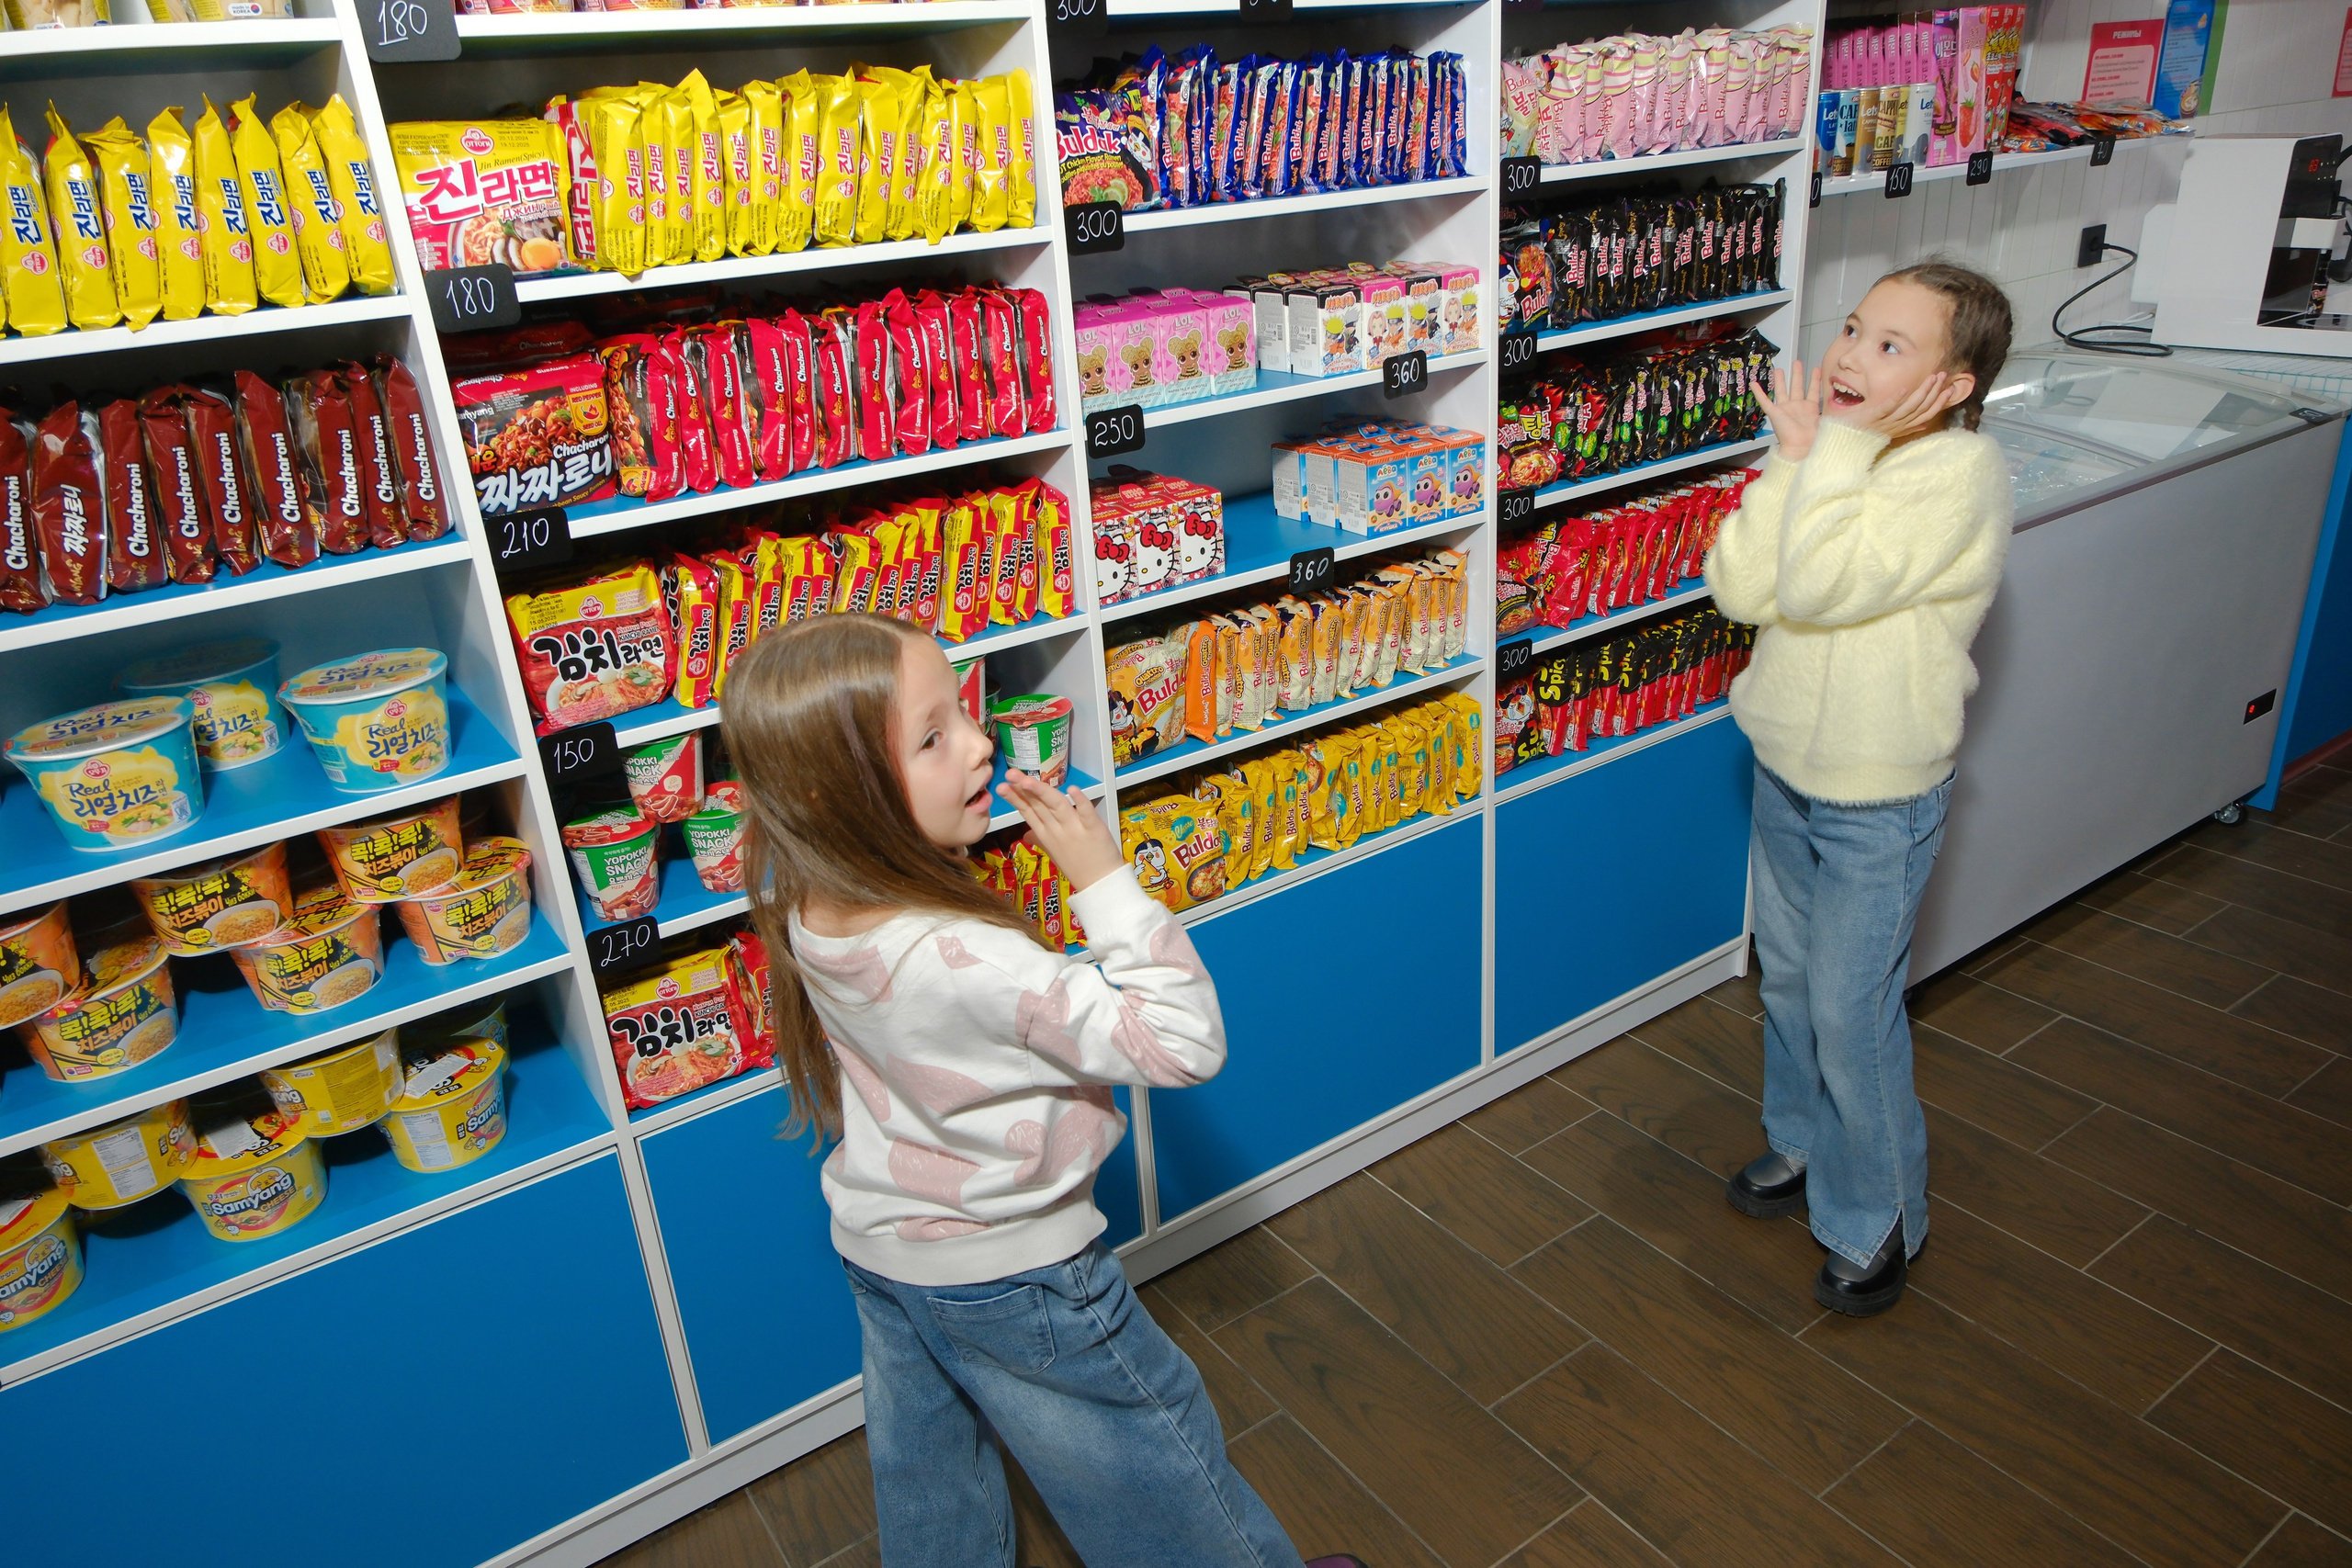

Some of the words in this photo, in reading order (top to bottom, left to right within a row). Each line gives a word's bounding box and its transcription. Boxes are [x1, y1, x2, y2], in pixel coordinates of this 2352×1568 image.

[379, 2, 427, 45] 180
[2113, 29, 2142, 39] РЕЖИМЫ
[1362, 109, 1373, 151] Buldak
[1387, 107, 1398, 148] Buldak
[1430, 107, 1442, 150] Buldak
[1455, 102, 1465, 140] Buldak
[1290, 118, 1302, 161] Buldak
[1318, 121, 1331, 162] Buldak
[1876, 136, 1894, 148] CAF
[480, 162, 492, 170] Jin
[494, 151, 545, 166] Ramen(Spicy)
[1508, 165, 1534, 191] 300
[416, 159, 555, 222] 진라면
[1890, 167, 1907, 190] 150
[9, 185, 43, 244] 진라면
[67, 180, 103, 240] 진라면
[1077, 209, 1117, 242] 300
[1650, 228, 1662, 267] Buldak
[1680, 226, 1694, 265] Buldak
[1702, 220, 1713, 260] Buldak
[1752, 216, 1764, 254] Buldak
[1597, 236, 1609, 277] Buldak
[1613, 238, 1624, 277] Buldak
[1634, 238, 1646, 278] Buldak
[446, 276, 495, 317] 180
[1371, 286, 1402, 307] NARUTO
[1410, 279, 1440, 299] NARUTO
[1448, 274, 1476, 294] NARUTO
[1326, 292, 1357, 313] NARUTO
[1077, 330, 1097, 343] LOL
[1128, 323, 1147, 335] LOL
[1175, 315, 1193, 327] LOL
[906, 327, 921, 368] Chacharoni
[933, 318, 946, 360] Chacharoni
[967, 318, 978, 360] Chacharoni
[1504, 337, 1532, 367] 300
[797, 337, 807, 382] Chacharoni
[830, 350, 842, 394] Chacharoni
[1391, 358, 1419, 389] 360
[570, 383, 597, 392] INCLUDING
[583, 392, 602, 401] PEPPER
[777, 423, 786, 455] Samyang
[1095, 415, 1134, 446] 250
[338, 429, 359, 517] Chacharoni
[371, 414, 394, 503] Chacharoni
[409, 412, 435, 502] Chacharoni
[172, 446, 199, 538] Chacharoni
[215, 431, 241, 525] Chacharoni
[271, 432, 300, 523] Chacharoni
[476, 445, 613, 513] 짜짜로니
[573, 492, 589, 502] Sauce
[590, 479, 605, 493] Ramen
[7, 475, 28, 570] Chacharoni
[64, 484, 88, 557] 짜짜로니
[129, 463, 149, 557] Chacharoni
[1504, 497, 1530, 520] 300
[503, 517, 548, 558] 210
[1295, 558, 1328, 583] 360
[619, 631, 640, 642] KIMCHI
[1502, 648, 1529, 671] 300
[193, 708, 212, 721] eal
[195, 714, 253, 741] 얼치즈
[362, 718, 405, 739] Real
[367, 723, 436, 758] 리얼치즈
[554, 739, 594, 773] 150
[62, 779, 110, 797] Real
[70, 784, 157, 818] 리얼치즈
[155, 779, 167, 795] 라면
[1389, 772, 1398, 801] Buldak
[688, 829, 730, 839] YOPOKKI
[1241, 825, 1252, 854] Buldak
[1286, 808, 1297, 837] Buldak
[604, 846, 647, 865] YOPOKKI
[691, 838, 734, 849] SNACK
[1171, 832, 1220, 872] Bulda
[605, 854, 650, 876] SNACK
[601, 925, 650, 966] 270
[211, 1170, 293, 1216] Samyang
[260, 1186, 295, 1212] CHEESE
[0, 1240, 65, 1301] amyang
[38, 1253, 69, 1288] CHEESE
